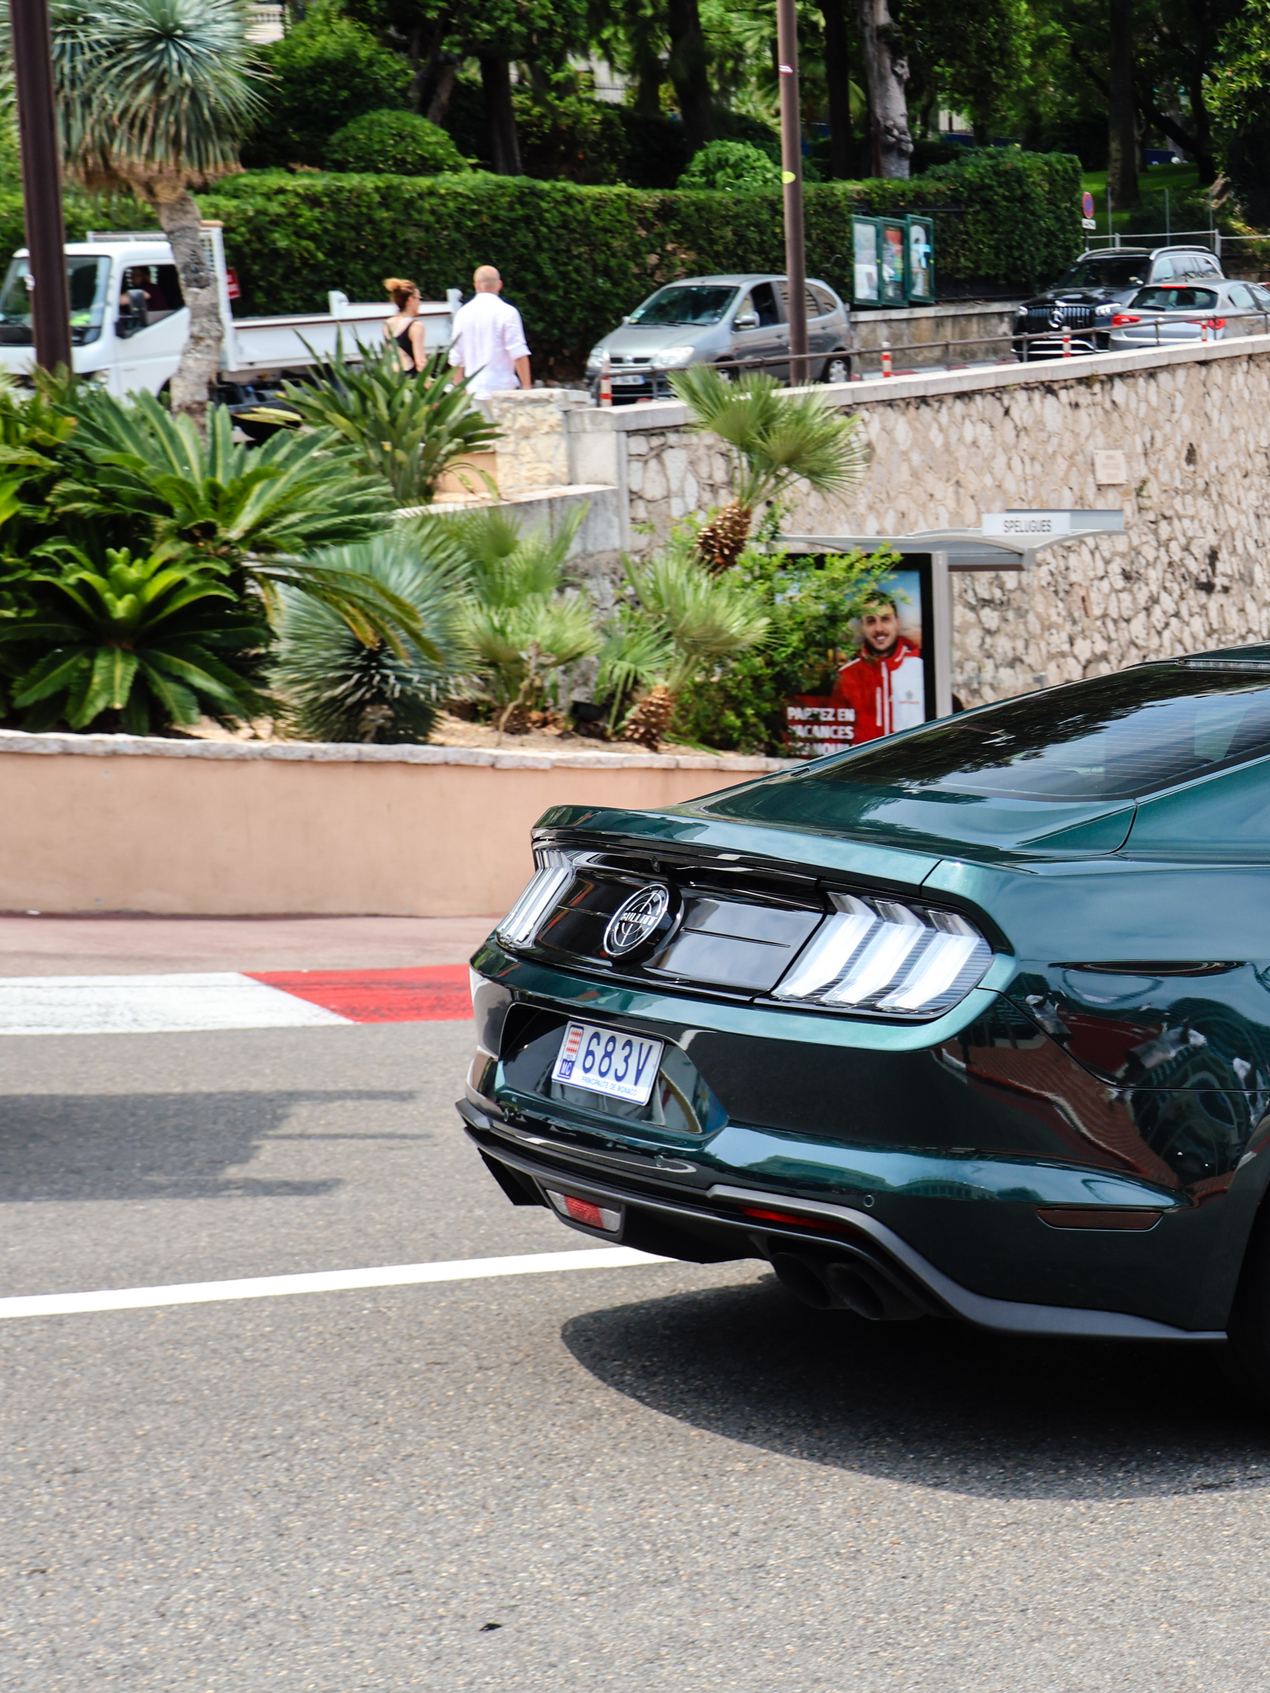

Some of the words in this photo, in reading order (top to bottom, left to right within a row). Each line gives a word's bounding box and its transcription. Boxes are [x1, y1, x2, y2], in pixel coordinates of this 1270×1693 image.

[837, 708, 856, 722] EN
[582, 1031, 653, 1087] 683V
[560, 1060, 572, 1076] MC
[609, 1082, 617, 1091] DE
[617, 1084, 638, 1097] MONACO
